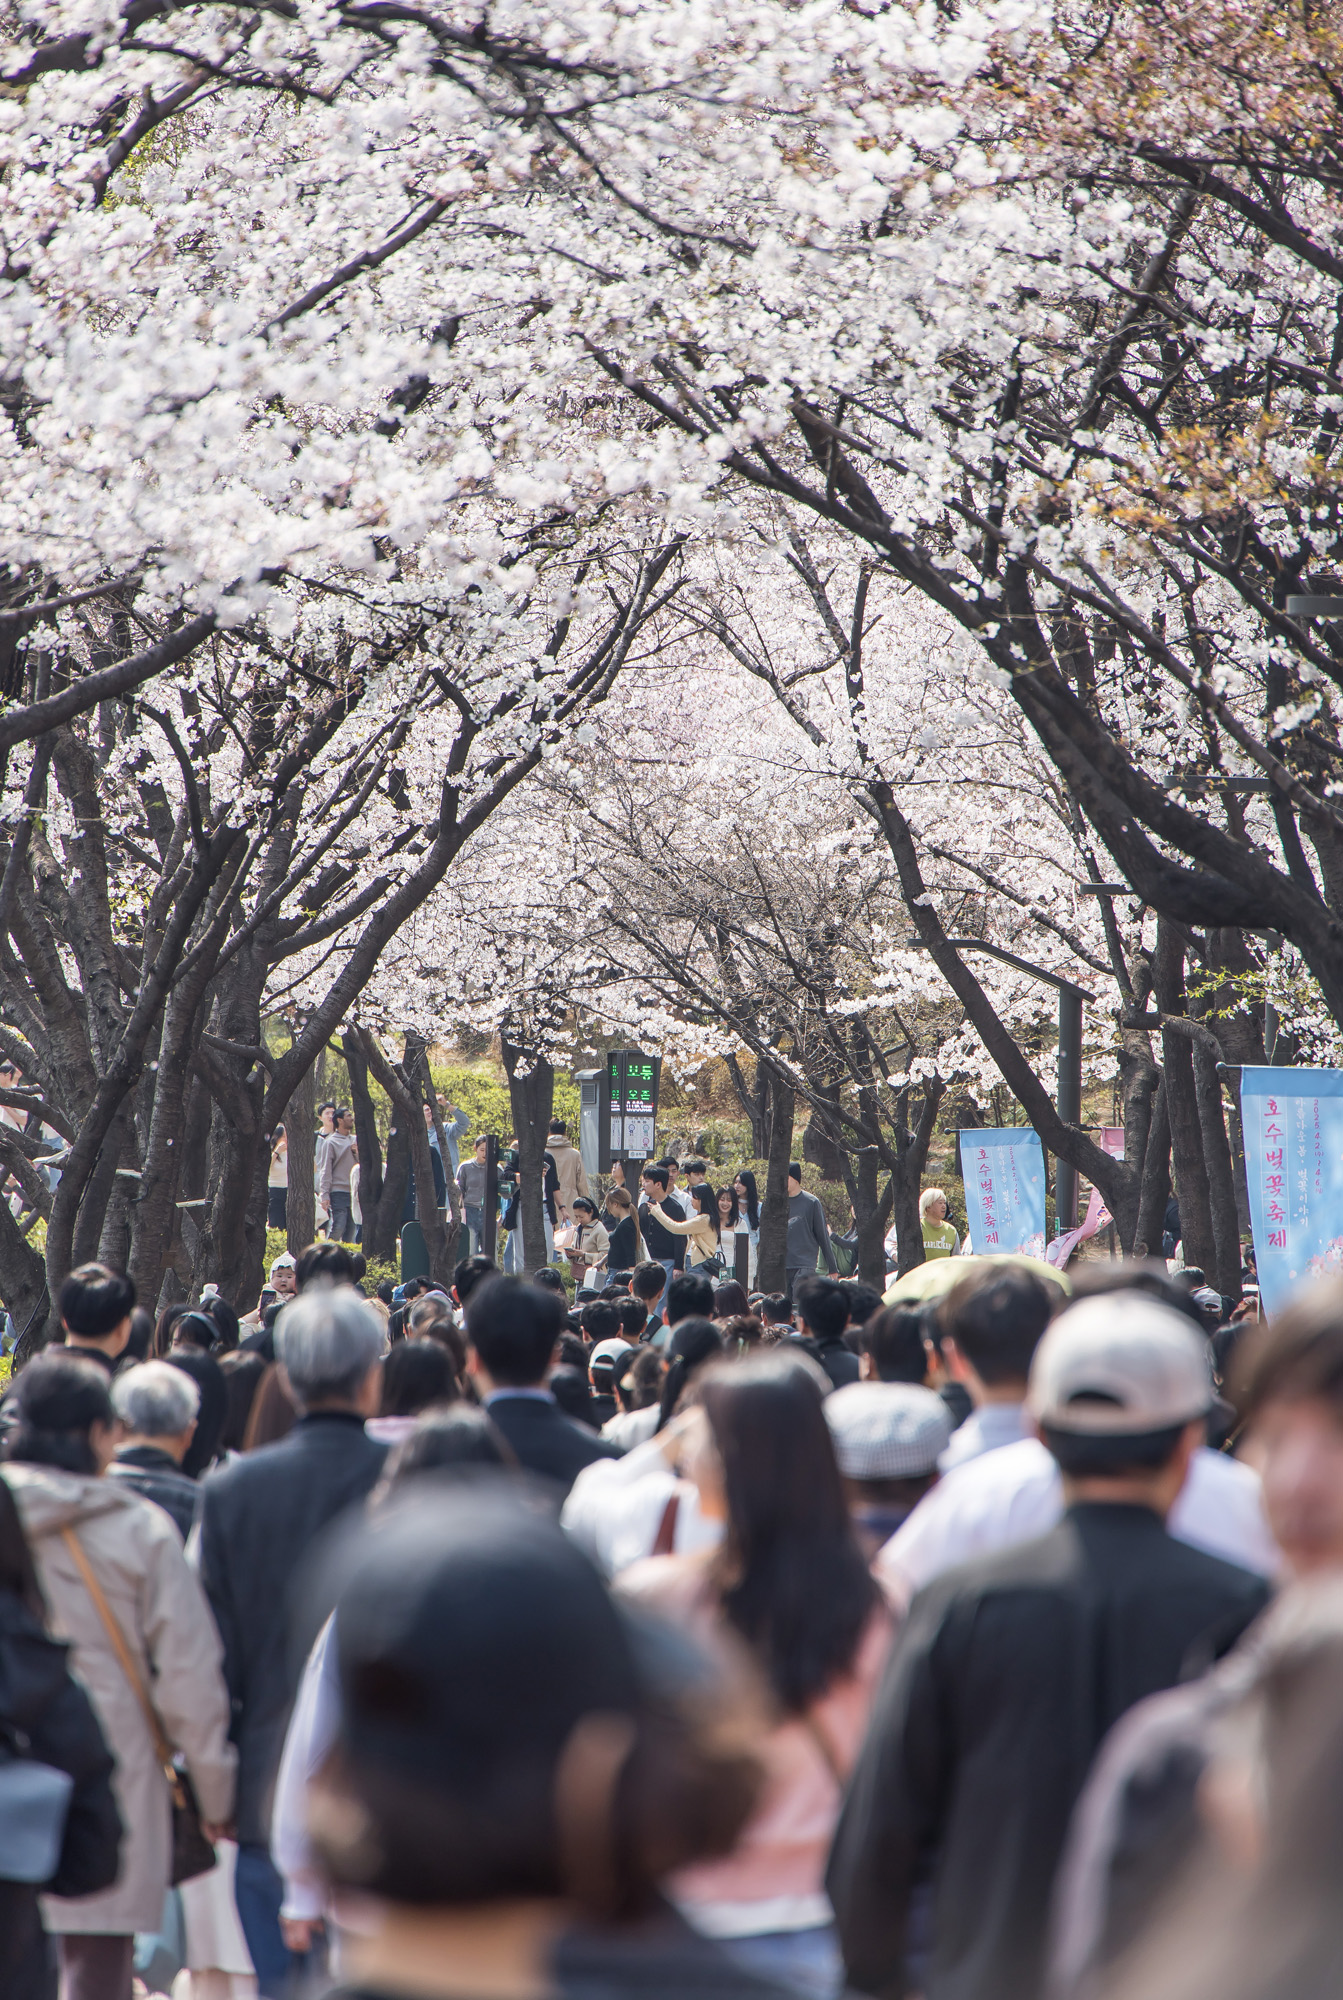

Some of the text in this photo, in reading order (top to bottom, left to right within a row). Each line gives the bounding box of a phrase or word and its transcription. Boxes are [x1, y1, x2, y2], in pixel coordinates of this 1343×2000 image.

[627, 1089, 650, 1100] 오존
[1296, 1097, 1307, 1142] 아름다운
[977, 1148, 999, 1244] 호수벚꽃축제
[1263, 1099, 1287, 1248] 호수벚꽃축제
